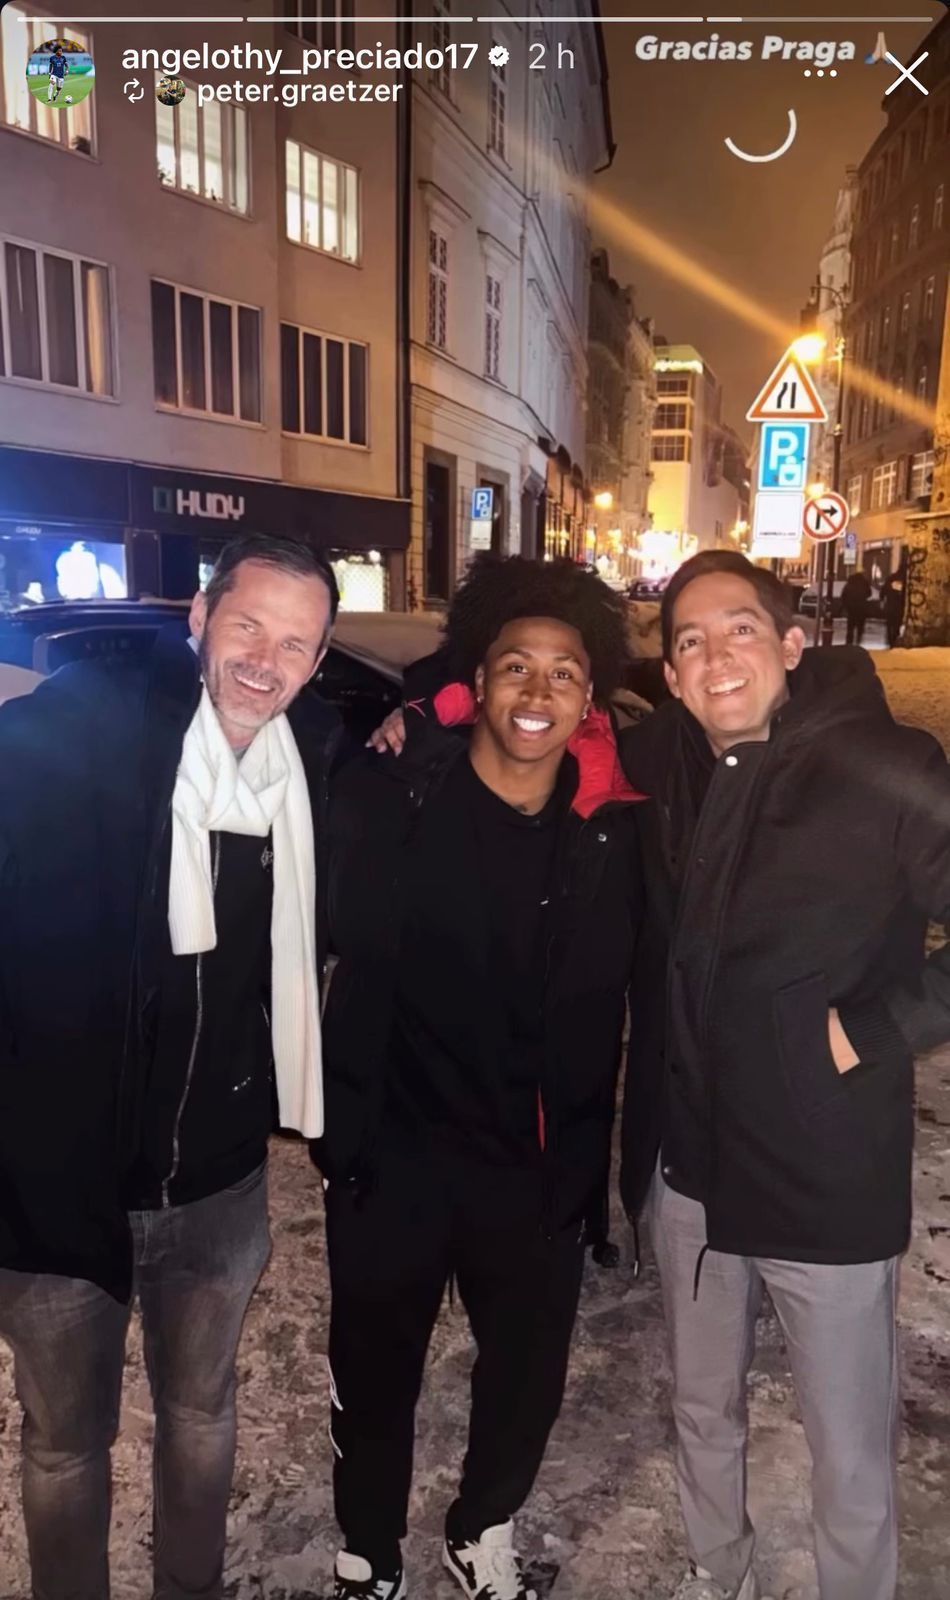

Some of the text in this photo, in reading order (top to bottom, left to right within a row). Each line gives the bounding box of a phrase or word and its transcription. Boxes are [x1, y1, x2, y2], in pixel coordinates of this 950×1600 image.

[769, 430, 799, 470] P
[176, 488, 245, 521] HUDY
[476, 492, 489, 510] P
